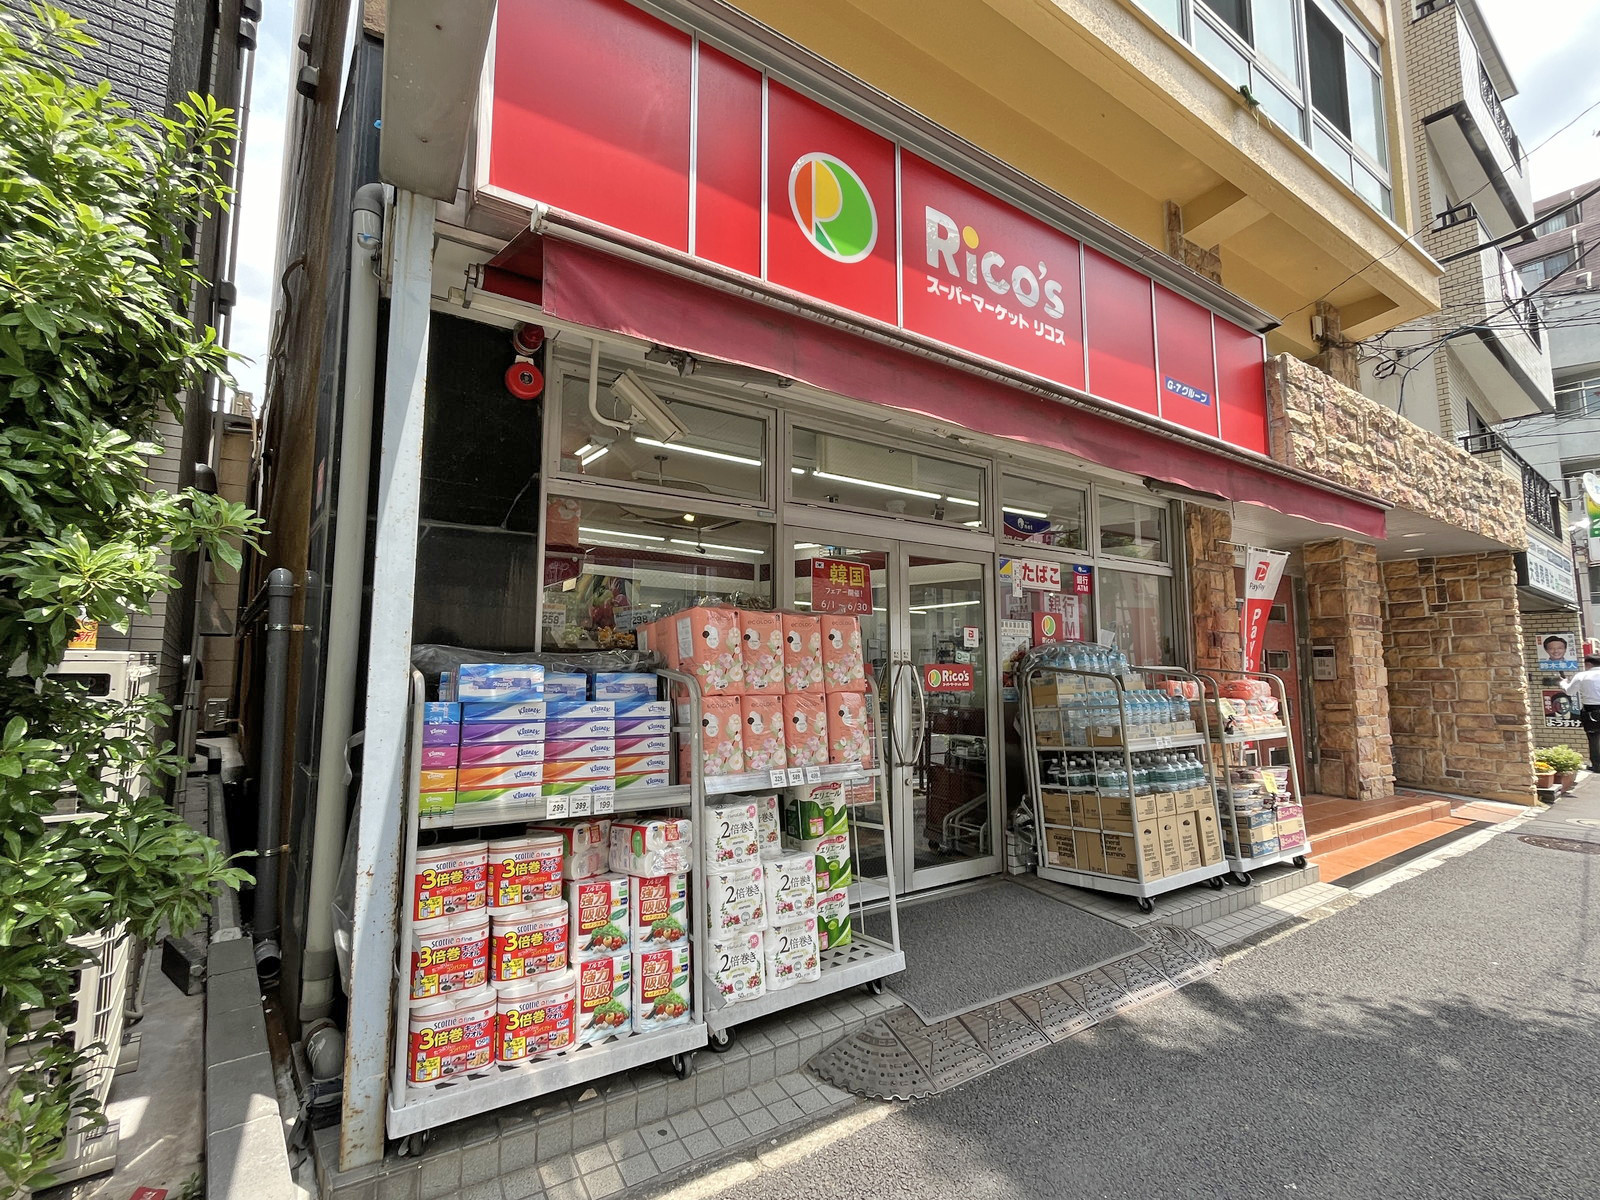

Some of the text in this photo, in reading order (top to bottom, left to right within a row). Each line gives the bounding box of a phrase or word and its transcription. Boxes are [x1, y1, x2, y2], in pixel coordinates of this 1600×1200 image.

[925, 205, 1065, 320] Rico's
[926, 275, 1066, 346] スーパーマーケット リコス
[829, 563, 865, 588] 韓国
[1022, 562, 1060, 585] たばこ
[1076, 584, 1089, 592] ATM
[632, 614, 648, 624] 298
[942, 669, 969, 682] Rico's
[517, 706, 541, 715] Kleenex
[590, 704, 610, 713] Kleenex
[517, 727, 540, 736] Kleenex
[590, 724, 610, 733] Kleenex
[515, 748, 539, 758] Kleenex
[590, 744, 610, 753] Kleenex
[590, 764, 610, 773] Kleenex
[646, 759, 665, 767] Kleenex
[514, 770, 537, 779] Kleenex
[645, 777, 664, 785] Kleenex
[813, 790, 842, 800] エリエール
[552, 804, 564, 812] 299
[575, 801, 587, 810] 399
[600, 801, 611, 809] 199
[720, 821, 754, 839] 2倍巻き
[820, 844, 846, 854] エリエール
[514, 851, 534, 860] scottie
[435, 861, 456, 871] scottie
[502, 858, 541, 878] 3倍巻
[421, 868, 464, 890] 3倍巻
[780, 874, 810, 891] 2倍巻き
[640, 885, 667, 900] 強力
[725, 884, 759, 904] 2倍巻き
[580, 892, 607, 908] 強力
[641, 898, 668, 914] 吸収
[581, 905, 608, 922] 吸収
[517, 923, 537, 933] scottie
[431, 937, 454, 948] scottie
[504, 931, 544, 952] 3倍巻
[544, 936, 561, 944] タオル
[779, 934, 812, 953] 2倍巻き
[417, 945, 461, 968] 3倍巻
[462, 951, 480, 959] タオル
[642, 959, 669, 976] 強力
[720, 951, 756, 973] 2倍巻き
[582, 967, 610, 985] 強力
[644, 973, 671, 990] 吸収
[583, 981, 611, 1000] 吸収
[519, 1000, 539, 1011] scottie
[505, 1009, 546, 1031] 3倍巻
[546, 1012, 563, 1020] タオル
[434, 1018, 457, 1030] scottie
[418, 1027, 463, 1051] 3倍巻
[464, 1031, 483, 1039] タオル
